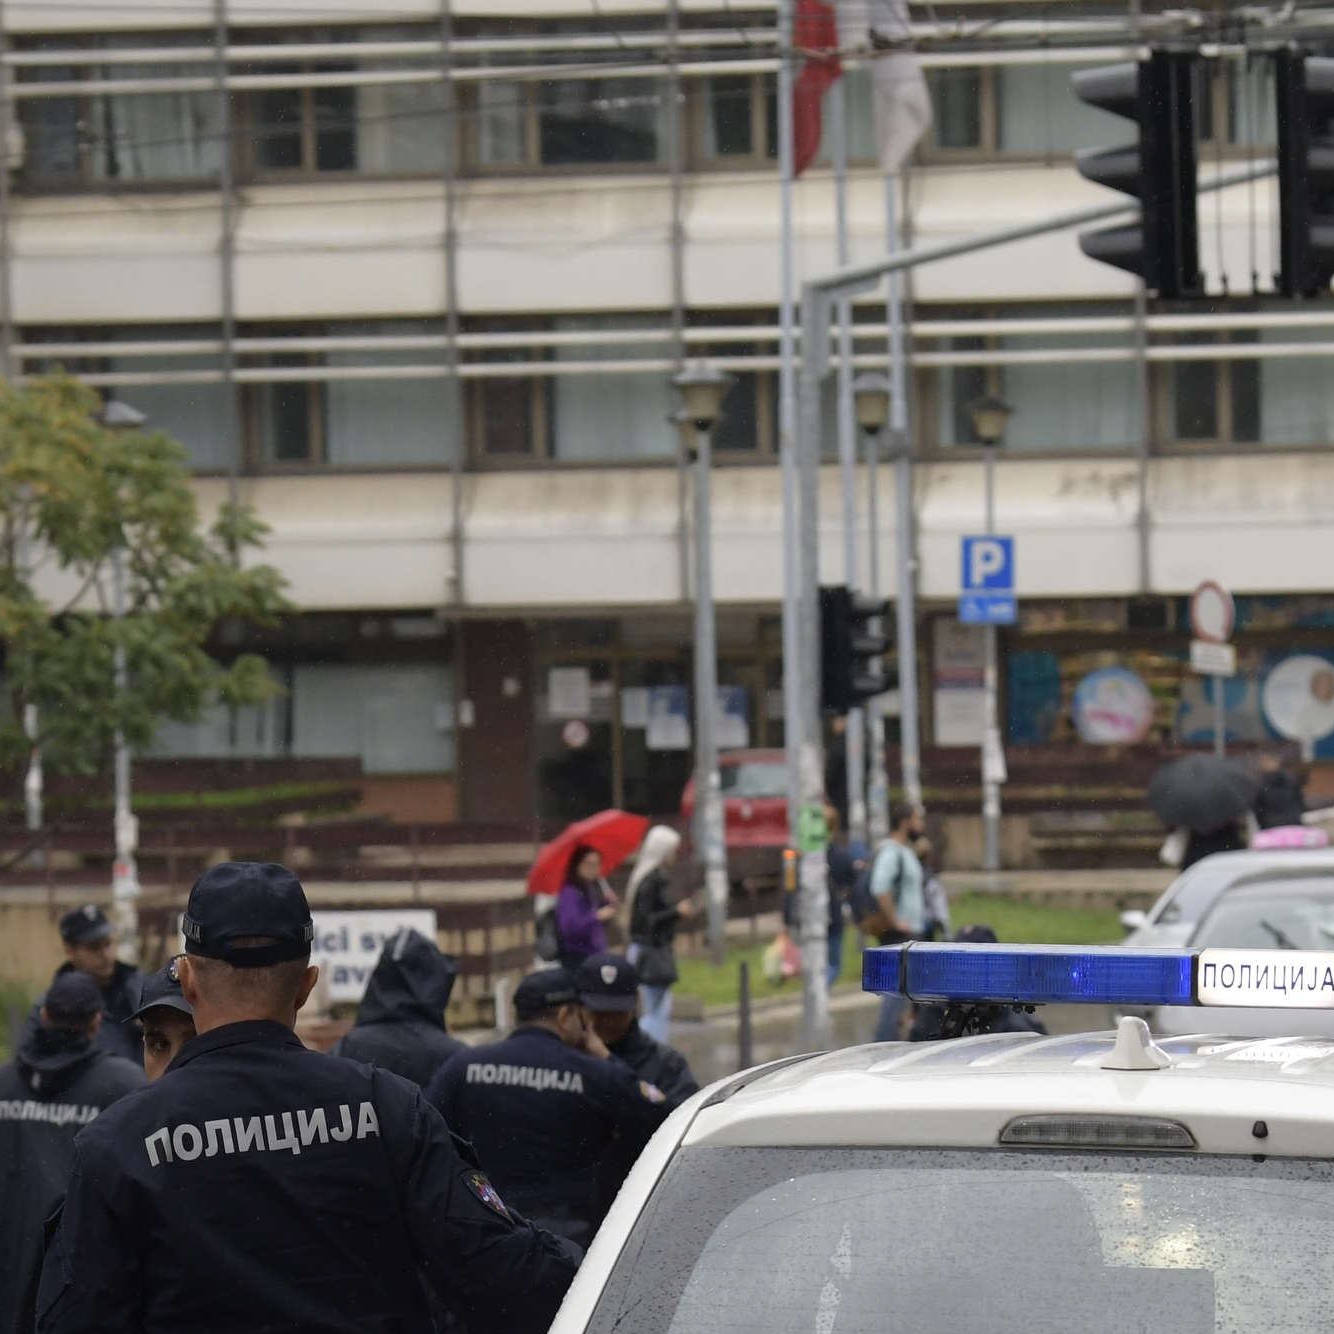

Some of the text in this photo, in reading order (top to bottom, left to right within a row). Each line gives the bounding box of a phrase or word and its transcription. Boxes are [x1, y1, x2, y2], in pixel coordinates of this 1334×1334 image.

[971, 542, 1006, 586] P
[466, 1063, 584, 1093] ПОЛИЦИЈА
[145, 1102, 381, 1168] ПОЛИЦИЈА
